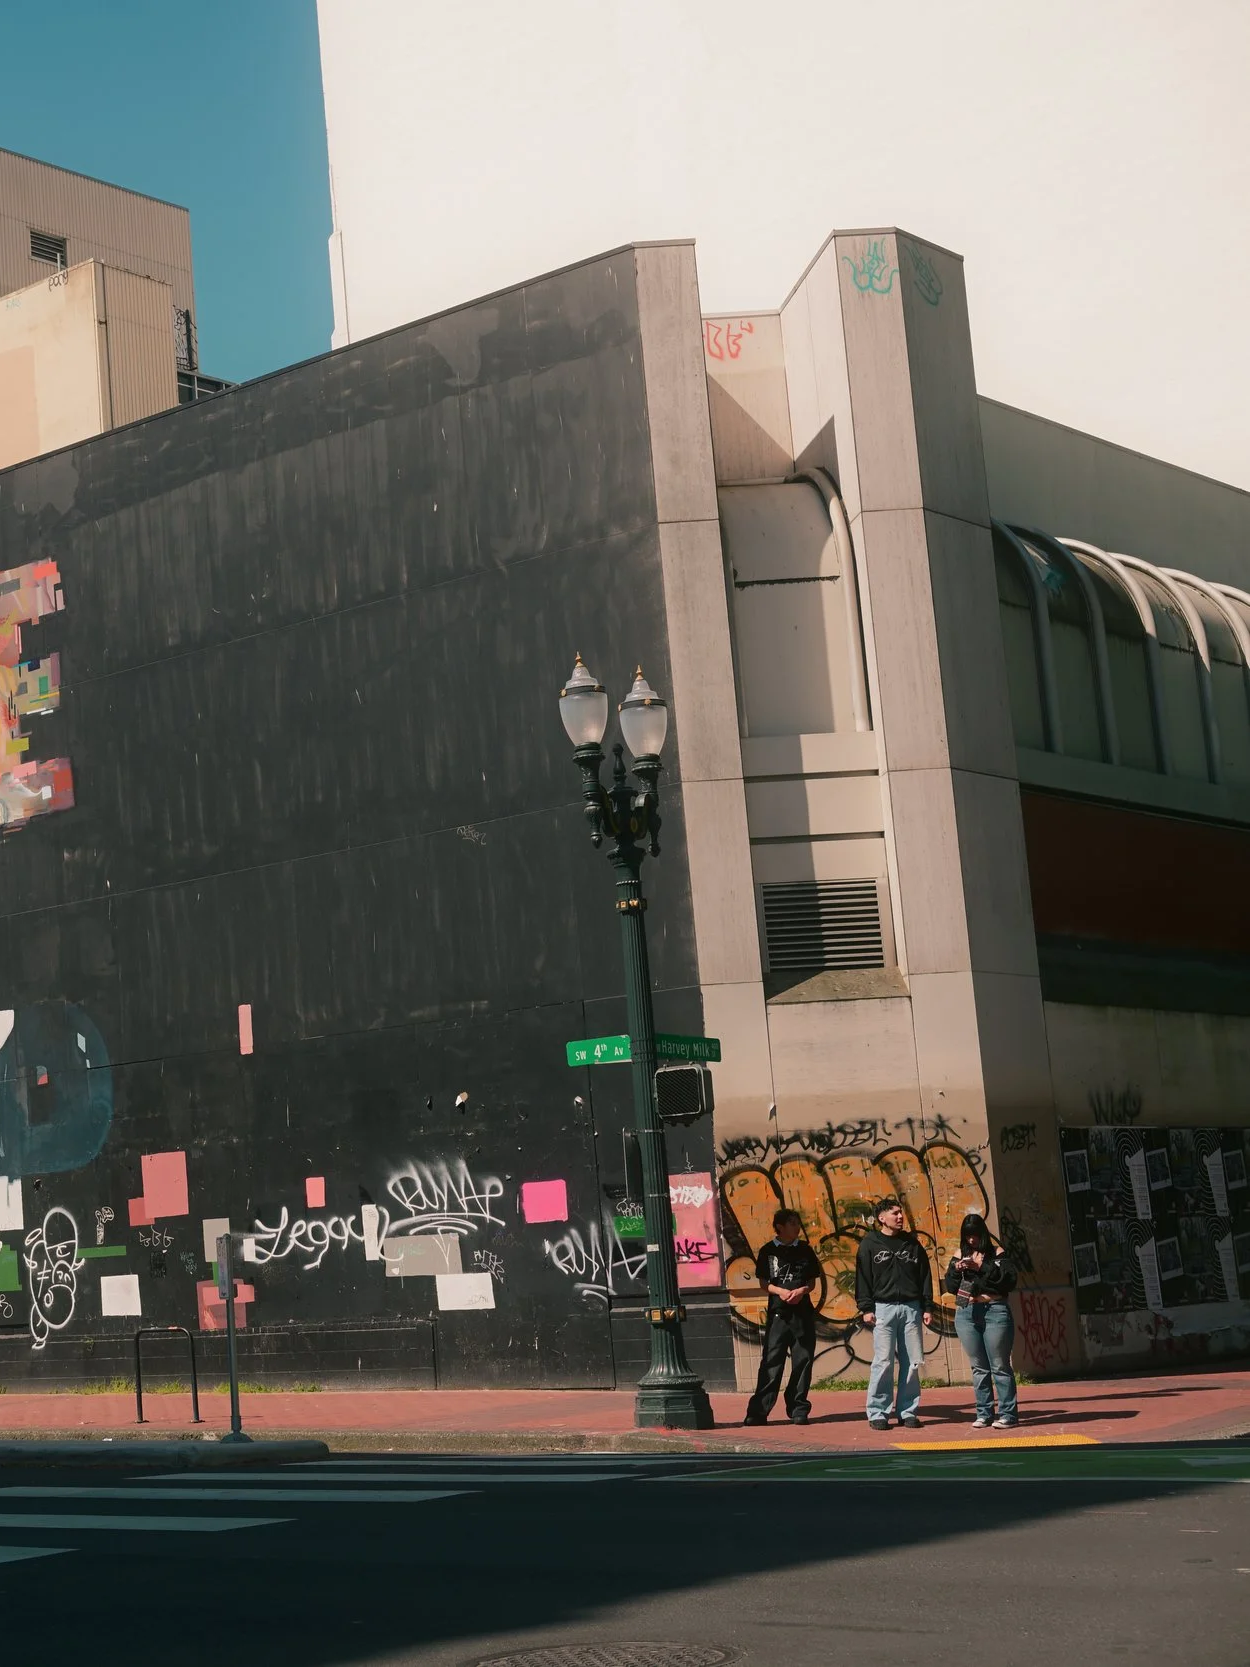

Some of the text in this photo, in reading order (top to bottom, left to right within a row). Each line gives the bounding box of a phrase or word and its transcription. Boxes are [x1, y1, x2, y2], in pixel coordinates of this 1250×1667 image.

[575, 1044, 624, 1061] SW 4th Av
[661, 1040, 690, 1059] Harvey
[693, 1042, 711, 1057] Milk
